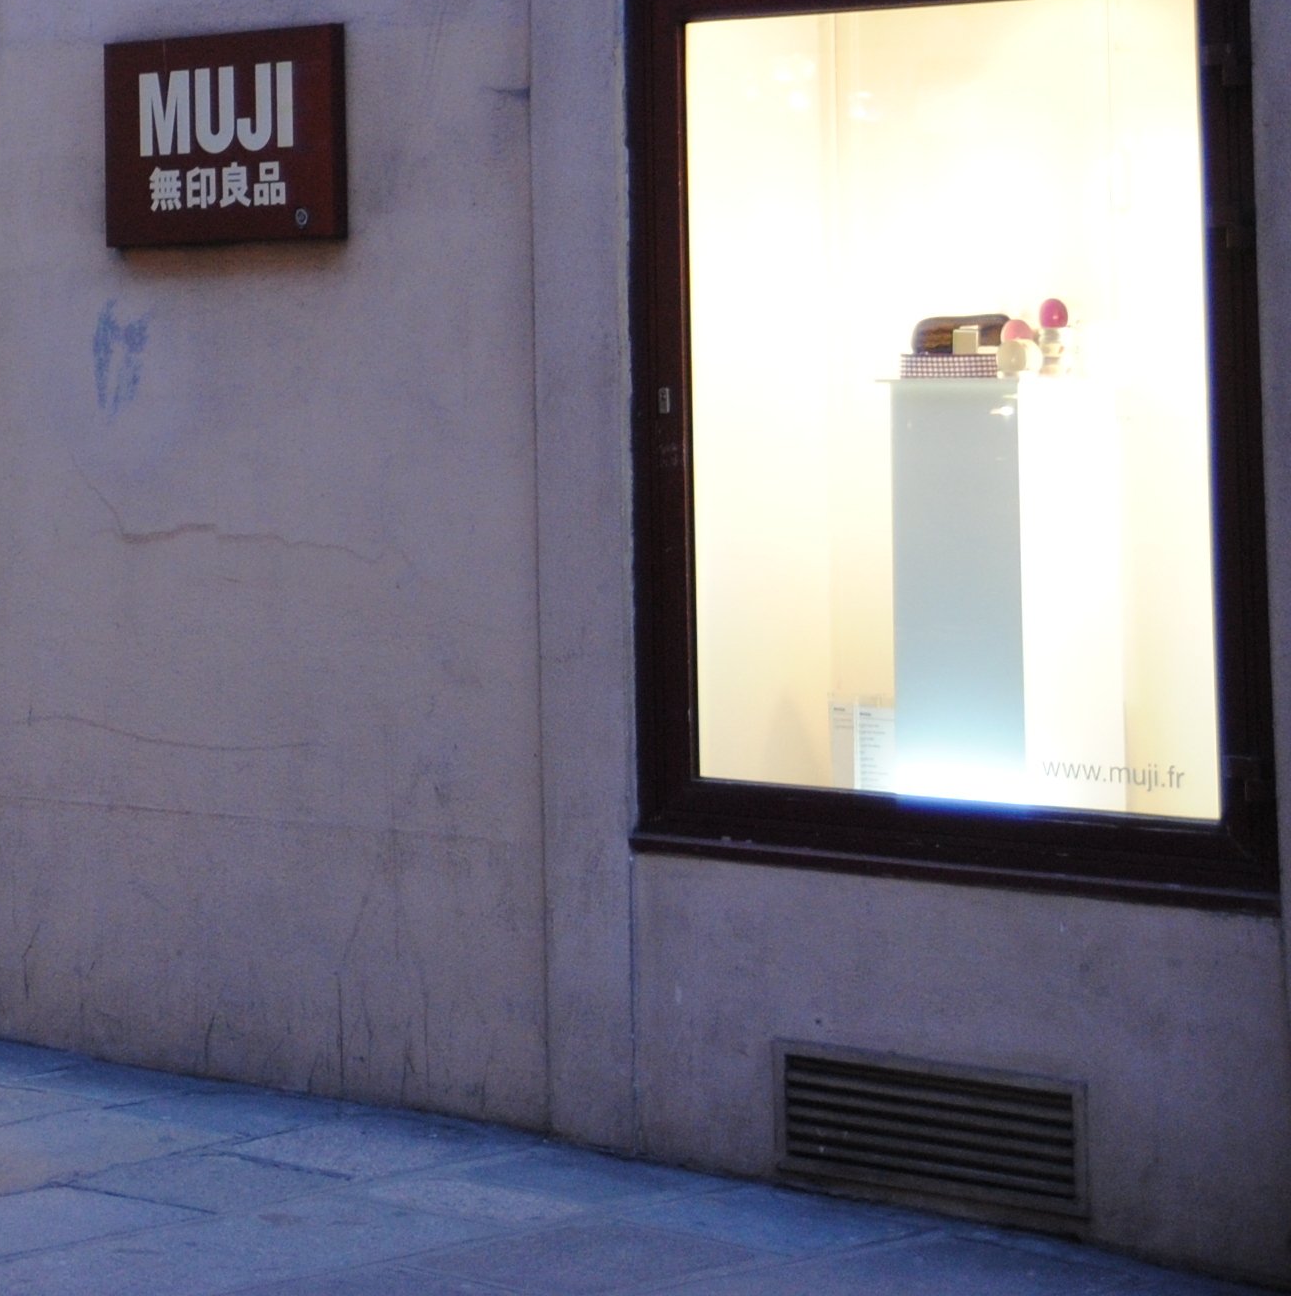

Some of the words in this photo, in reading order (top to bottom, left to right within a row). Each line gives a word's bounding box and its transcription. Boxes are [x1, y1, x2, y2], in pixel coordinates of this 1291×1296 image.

[138, 61, 294, 157] MUJI
[149, 161, 286, 212] 無印良品
[1042, 761, 1185, 792] www.muji.fr
